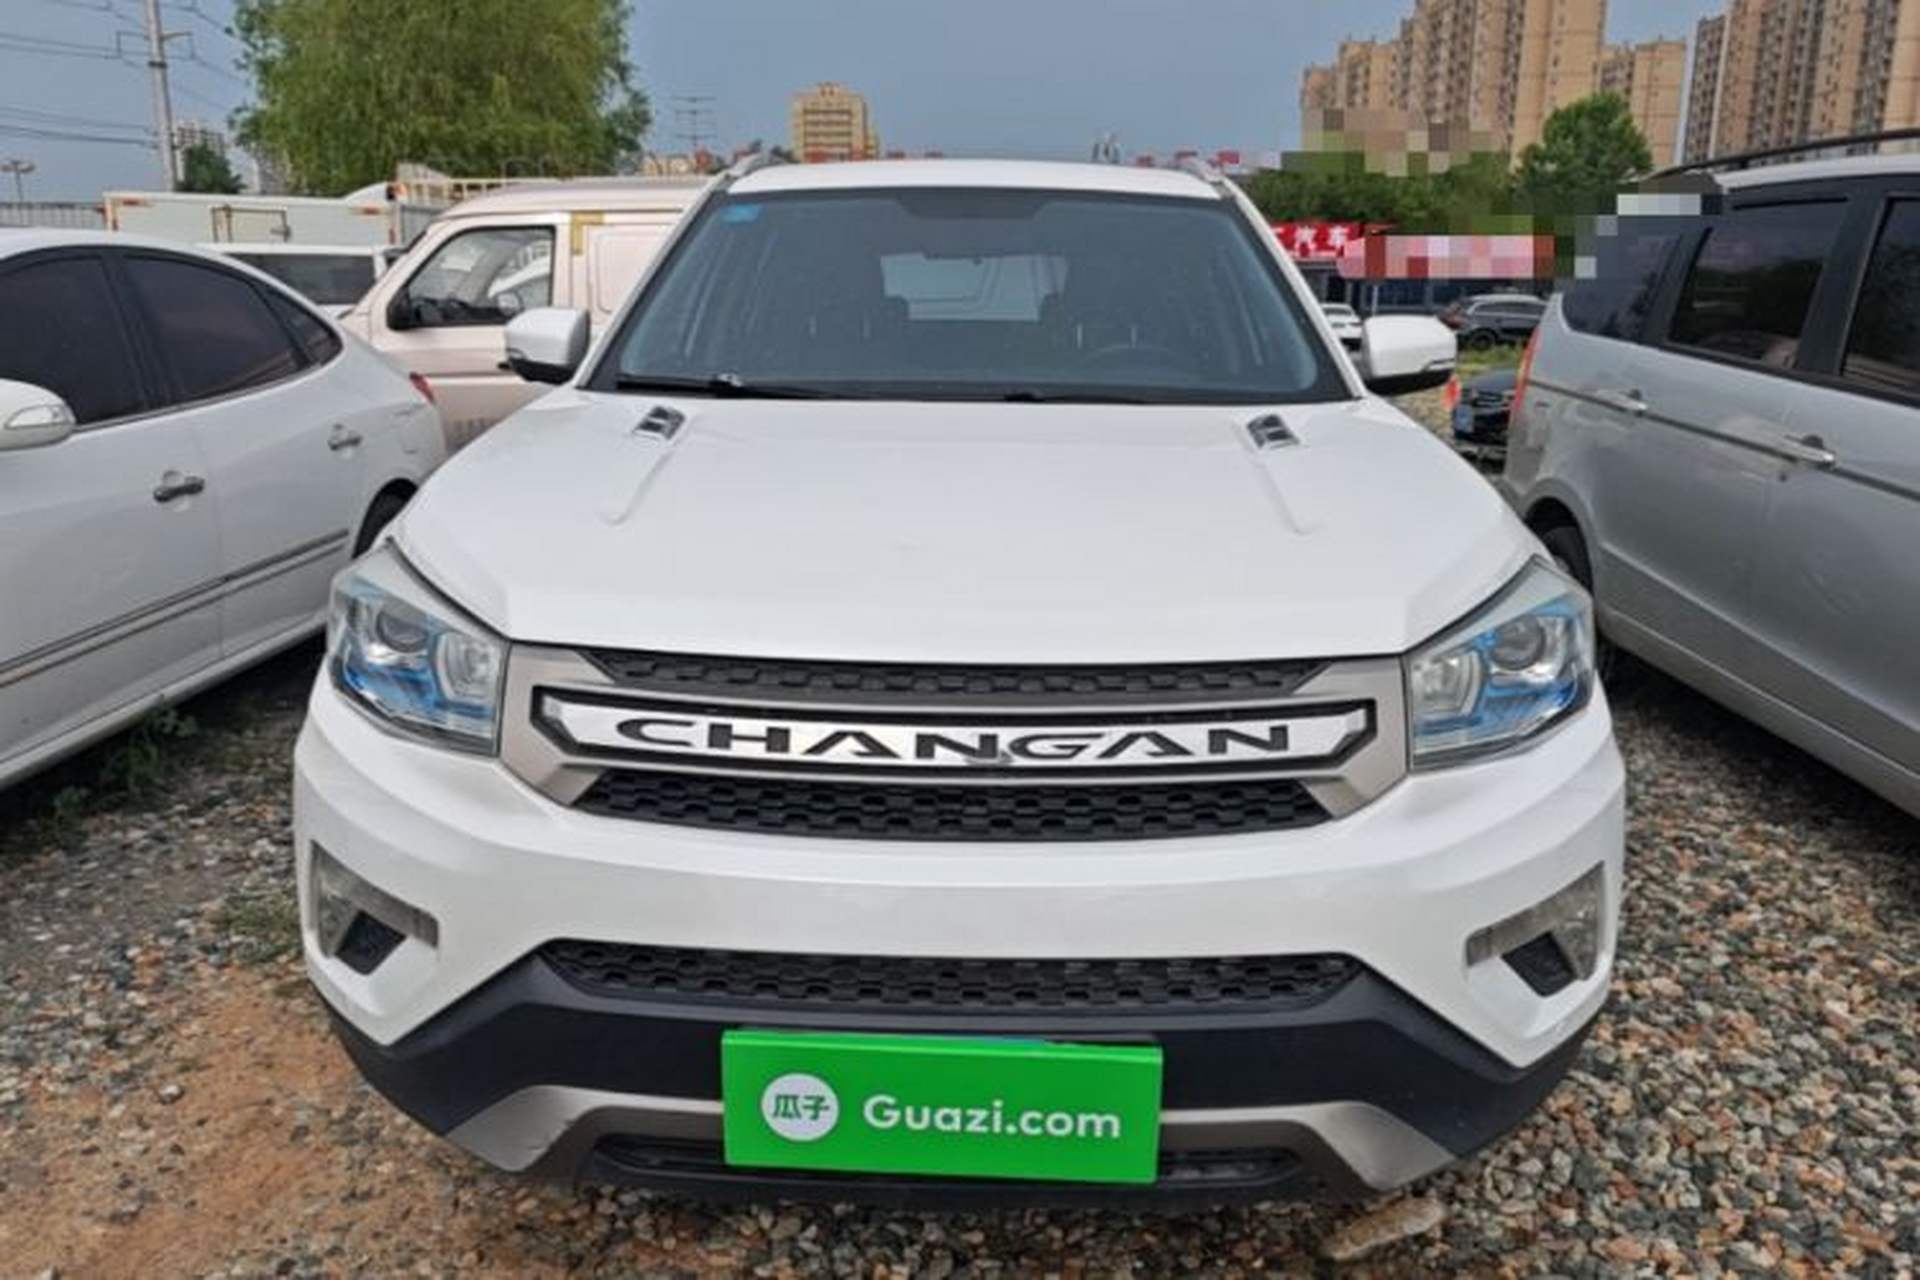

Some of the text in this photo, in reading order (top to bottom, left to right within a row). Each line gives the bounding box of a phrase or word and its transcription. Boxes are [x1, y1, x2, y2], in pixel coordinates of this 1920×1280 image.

[616, 718, 1290, 760] CHANGAN
[772, 1094, 830, 1120] 瓜子
[863, 1095, 1121, 1139] Guazi.com
